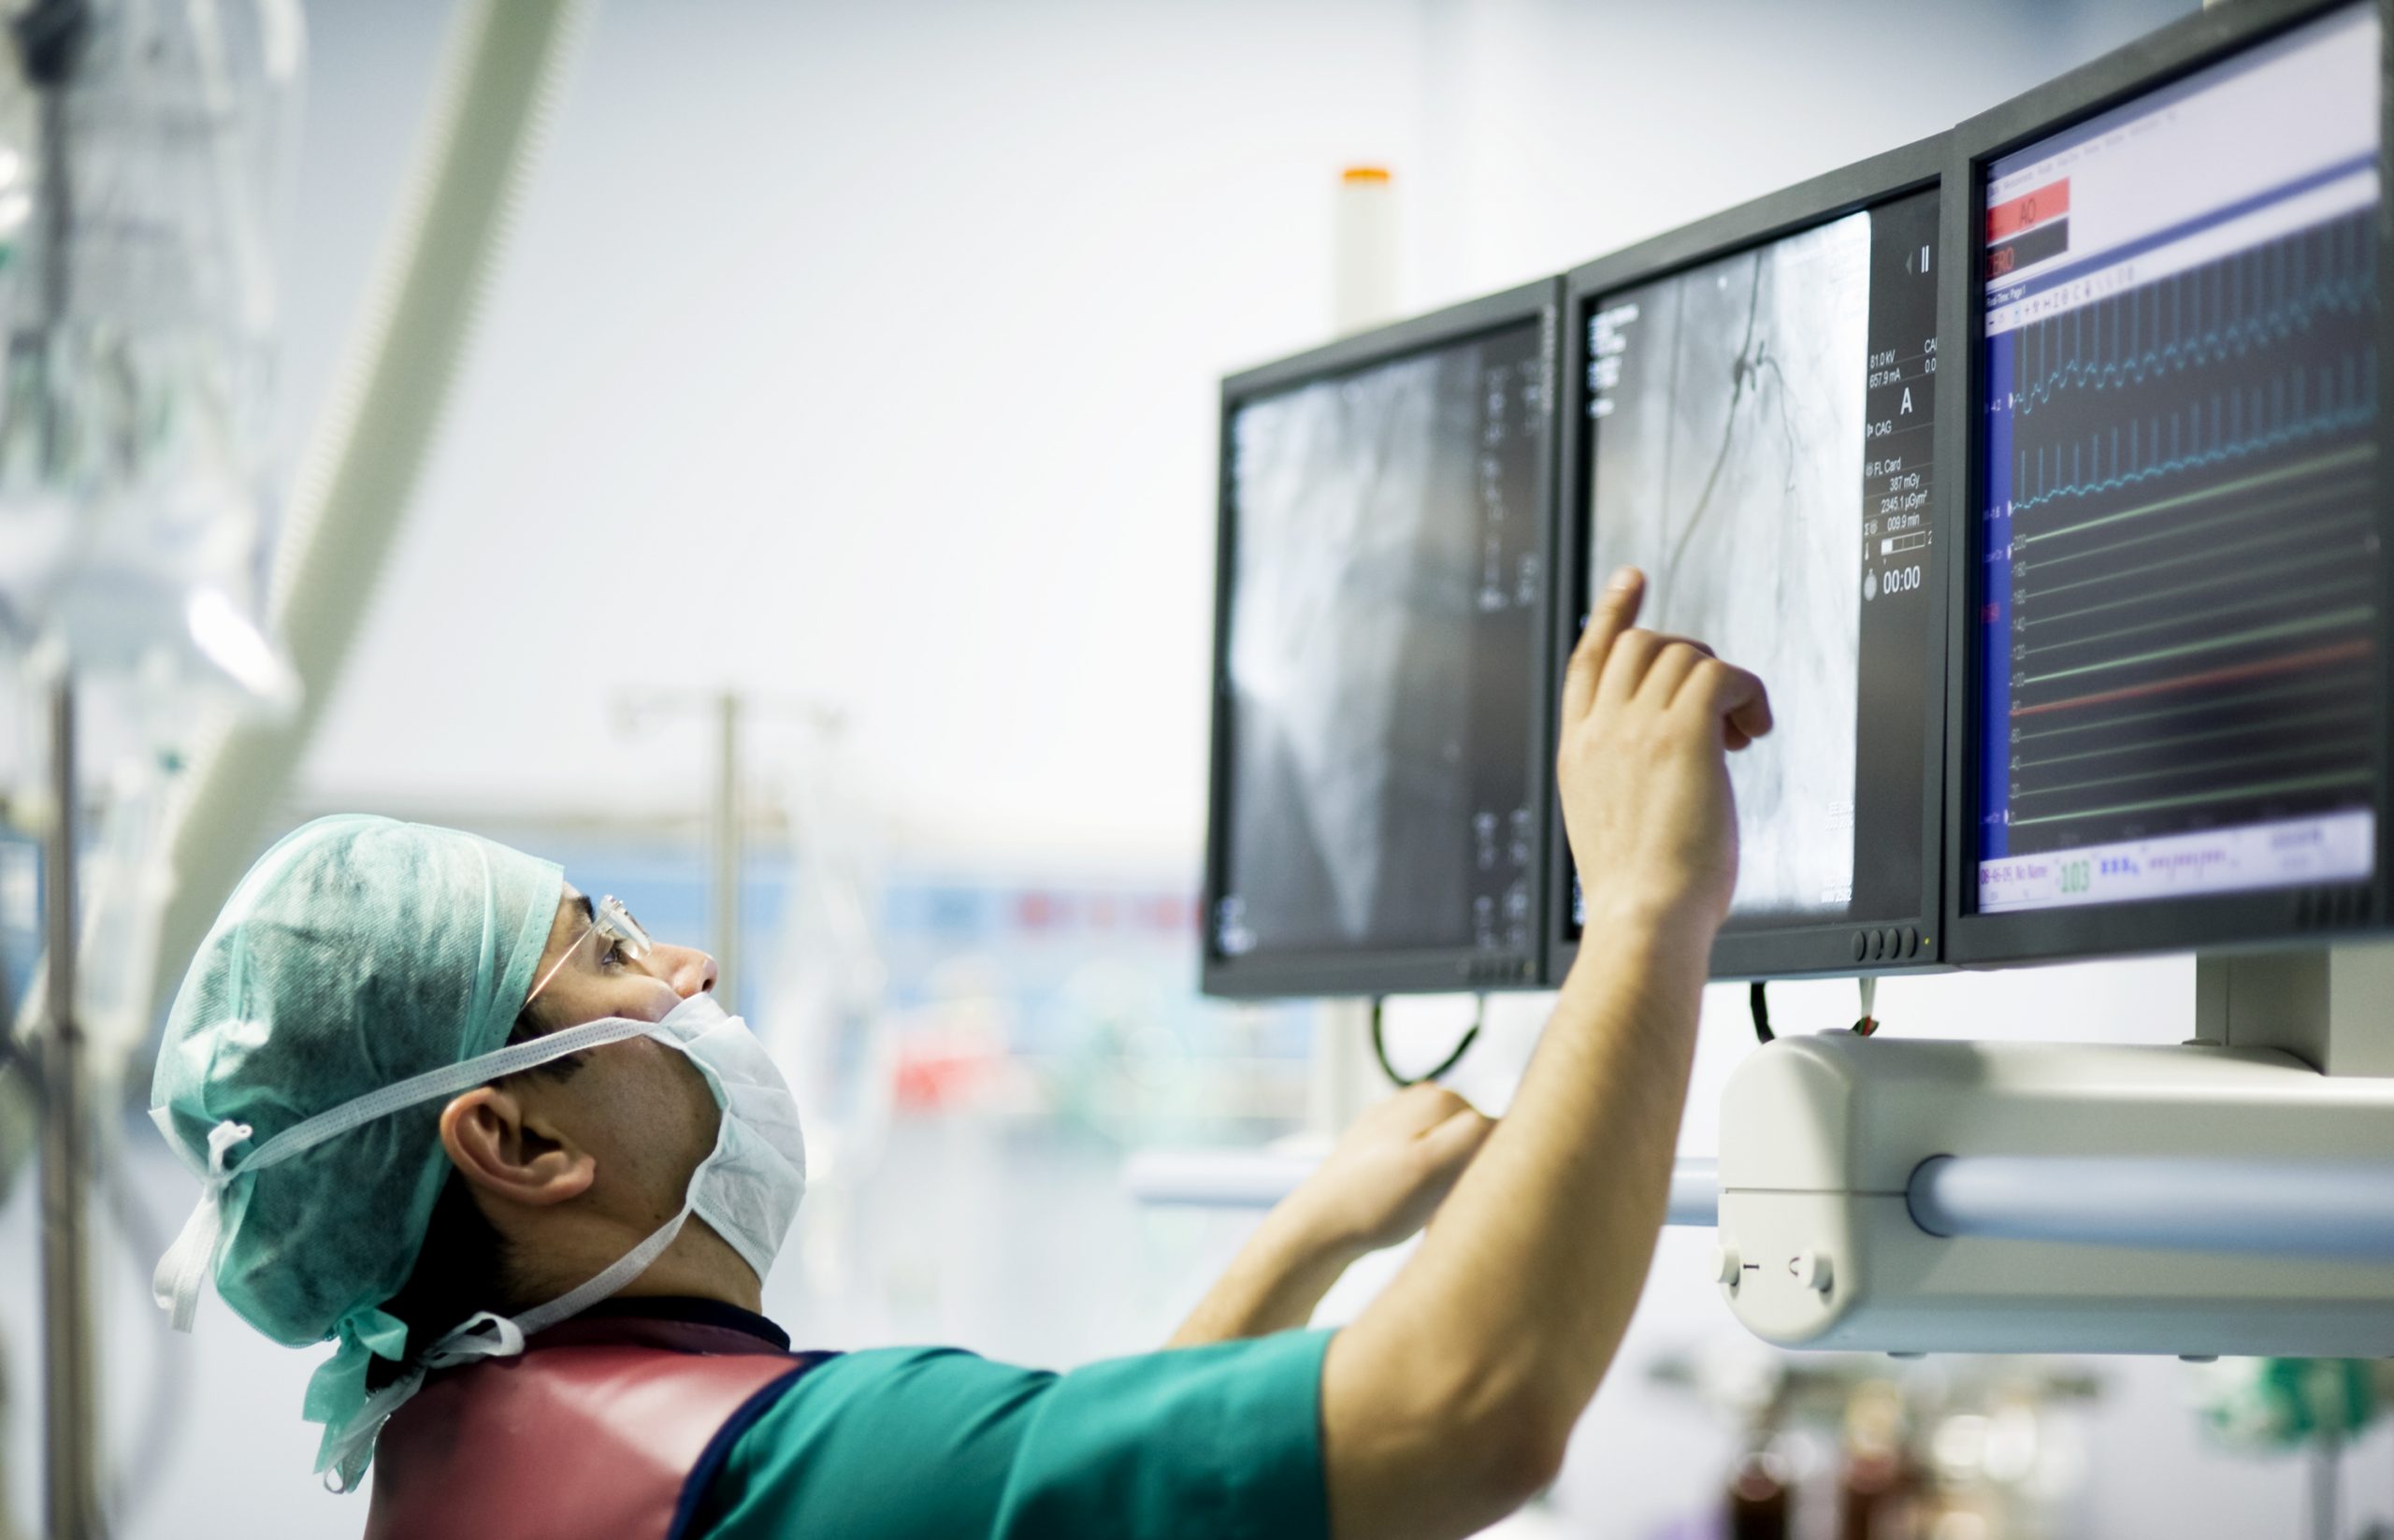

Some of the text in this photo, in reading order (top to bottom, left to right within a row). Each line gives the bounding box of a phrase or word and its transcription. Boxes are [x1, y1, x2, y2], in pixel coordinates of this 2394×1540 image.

[1889, 367, 1901, 382] mA
[1900, 386, 1913, 415] A
[1875, 420, 1893, 438] CAG
[1874, 456, 1901, 476] FL Card
[1903, 472, 1921, 489] mGy
[1907, 511, 1920, 527] min
[1882, 565, 1921, 595] 00:00
